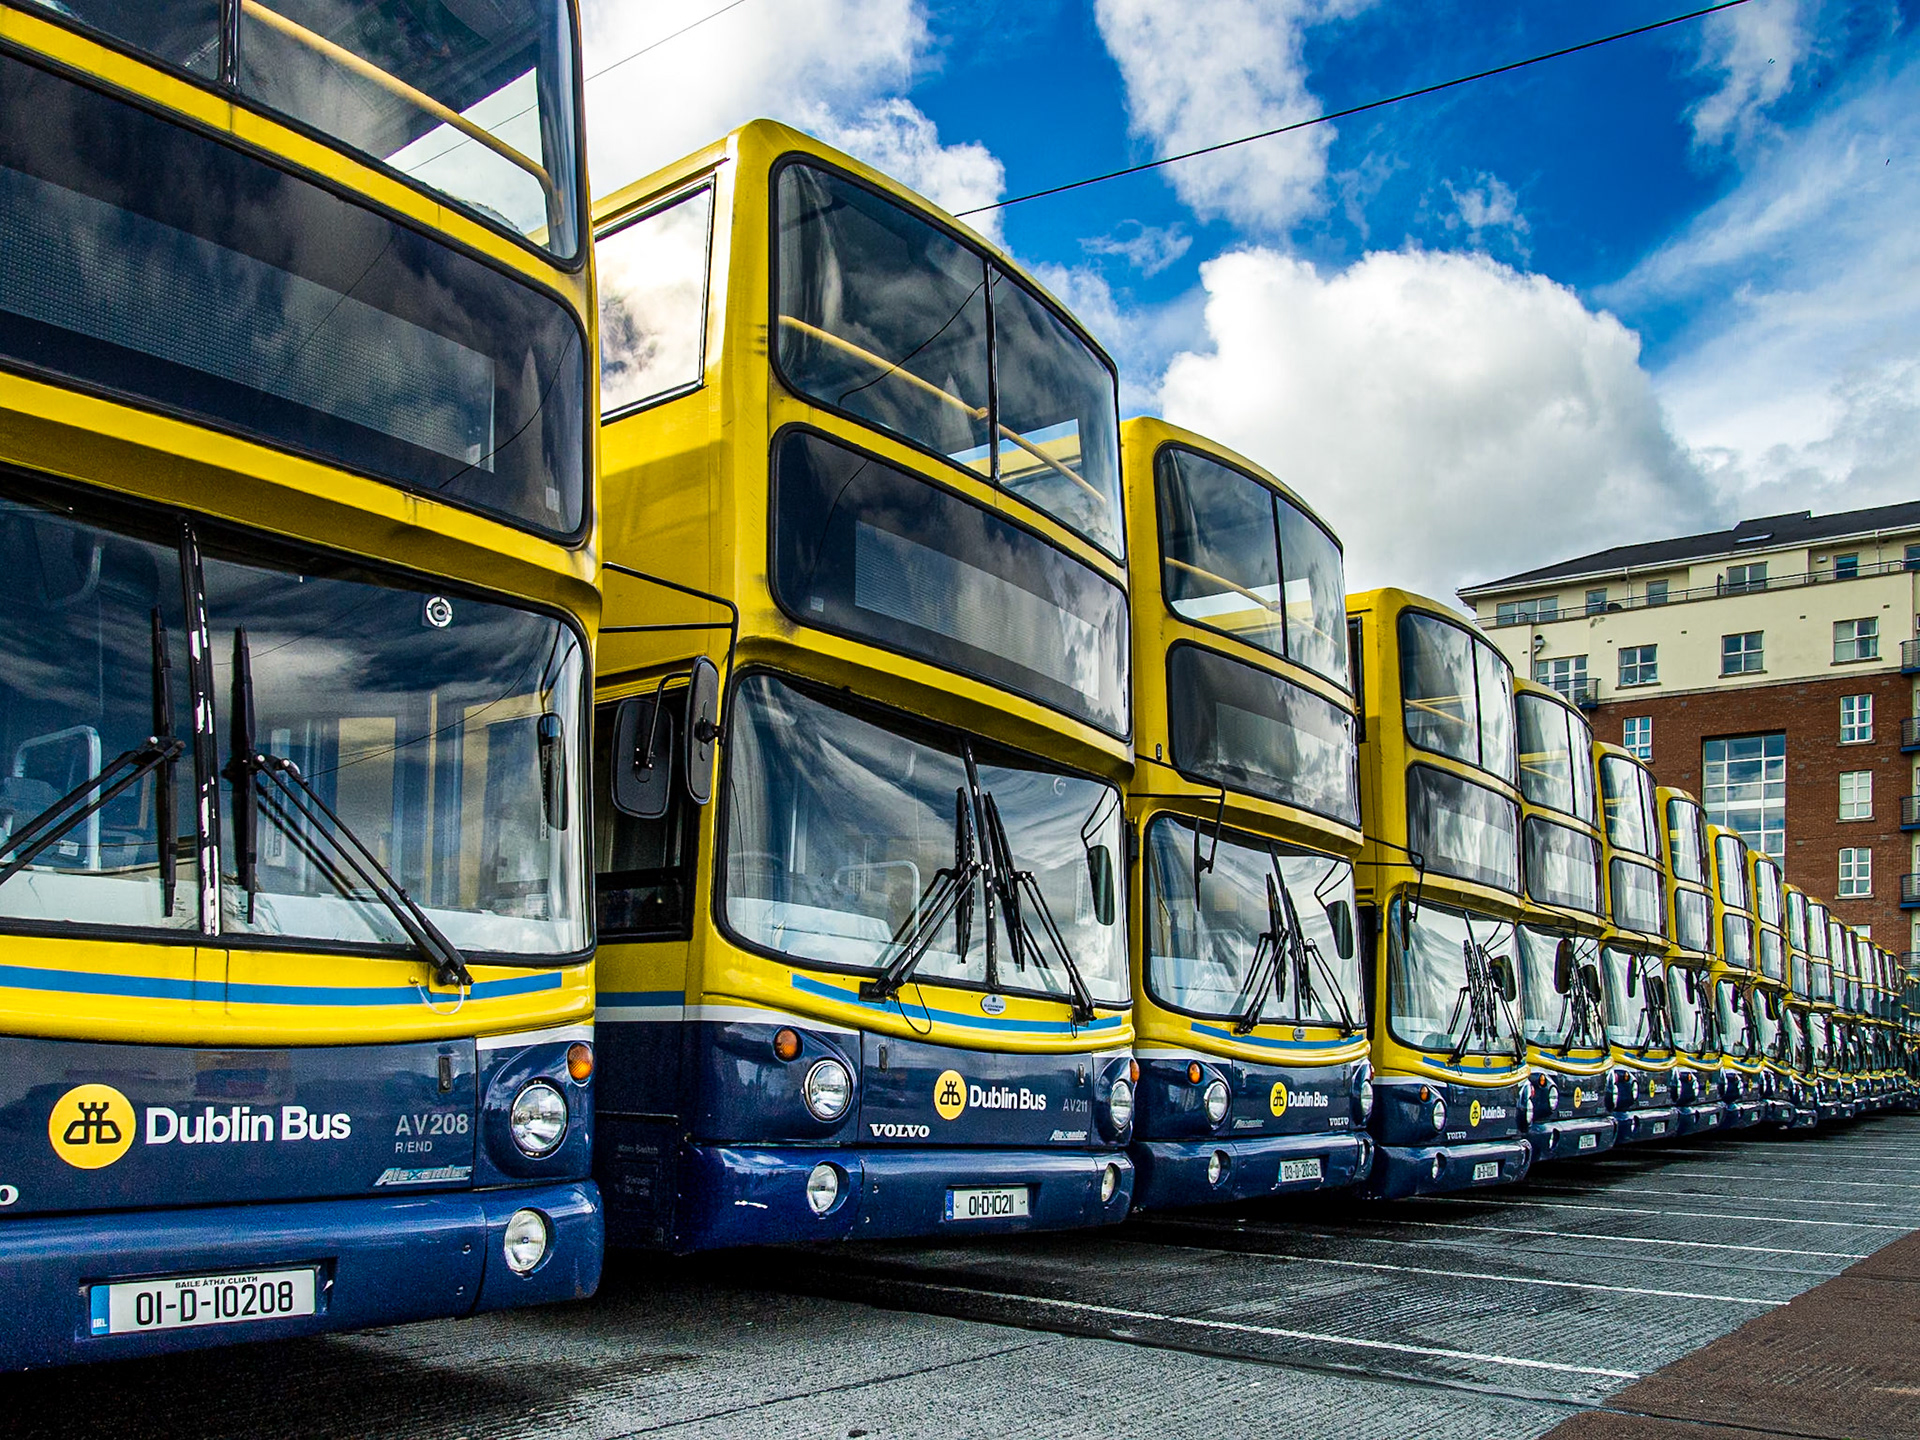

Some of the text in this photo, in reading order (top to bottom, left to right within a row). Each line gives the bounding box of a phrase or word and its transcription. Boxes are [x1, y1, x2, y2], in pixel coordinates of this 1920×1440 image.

[969, 1084, 1047, 1110] Dublin Bus
[1288, 1091, 1328, 1107] Dublin Bus
[1063, 1098, 1088, 1113] AV211
[145, 1105, 351, 1144] Dublin Bus
[395, 1113, 469, 1136] AV208
[869, 1123, 930, 1138] VOLVO
[394, 1140, 433, 1154] R/END
[373, 1164, 473, 1187] Alexander
[175, 1279, 201, 1289] BAILE
[227, 1276, 258, 1285] CLIATH
[136, 1281, 294, 1326] 01-D-10208
[92, 1318, 107, 1328] IRL
